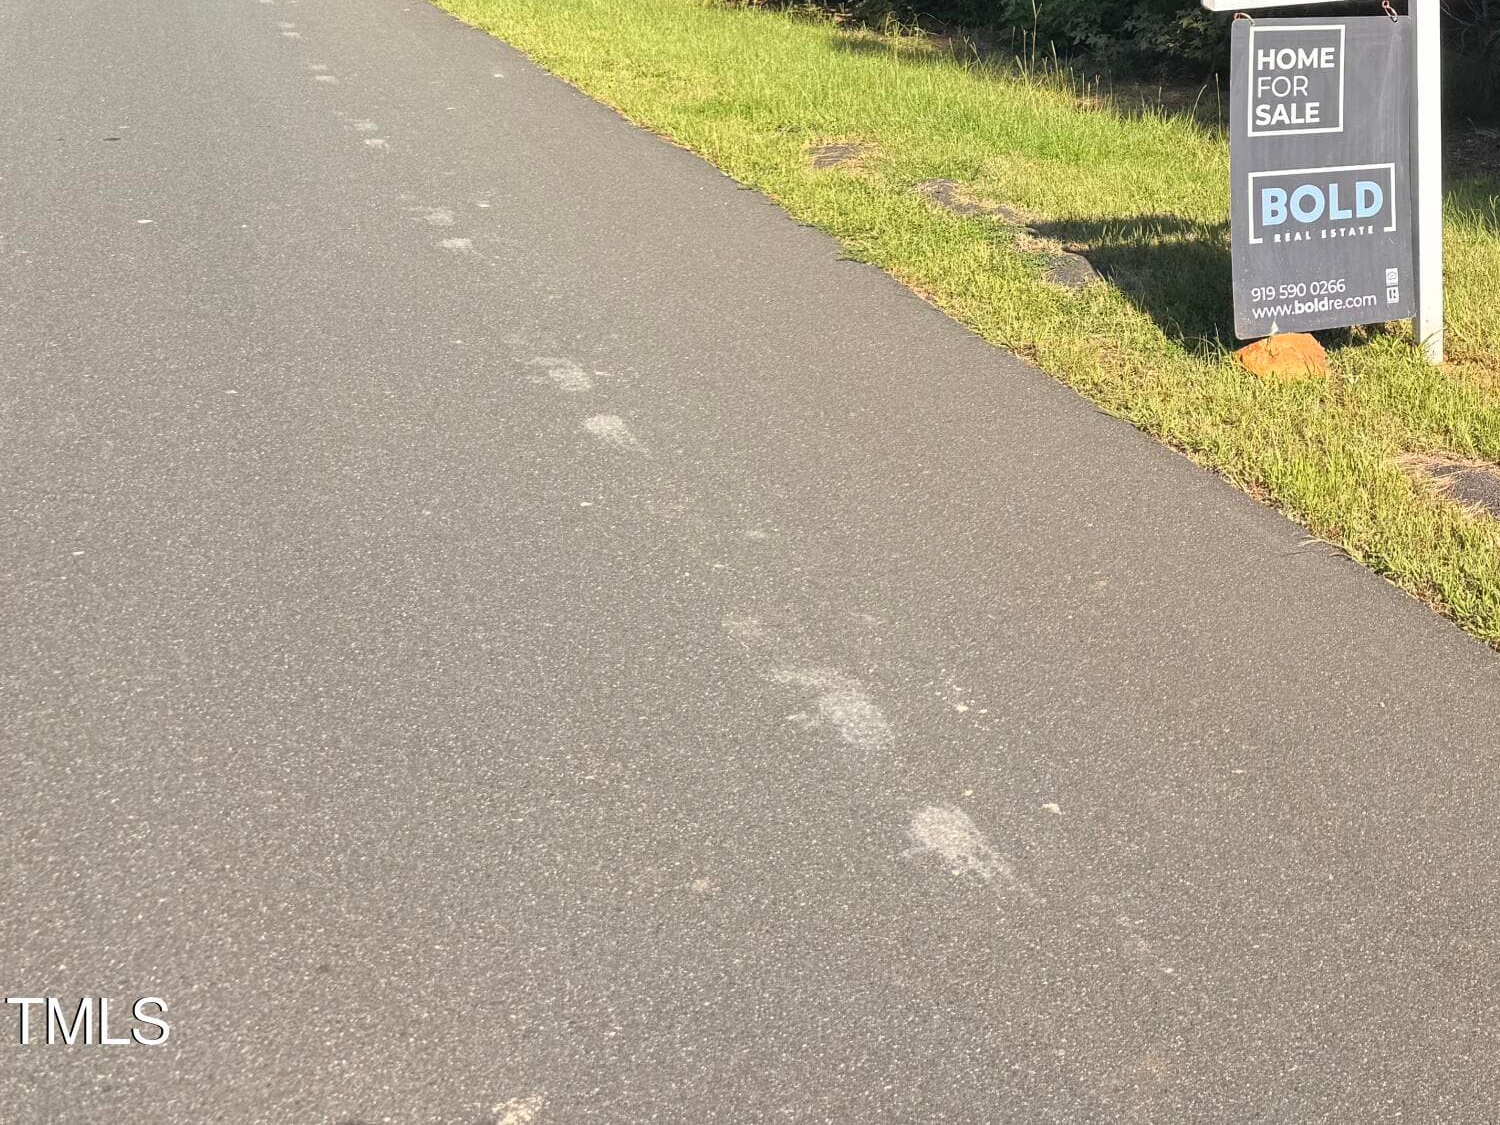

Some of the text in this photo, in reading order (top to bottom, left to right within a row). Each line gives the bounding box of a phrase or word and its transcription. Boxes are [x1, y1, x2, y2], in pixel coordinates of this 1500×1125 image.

[1257, 47, 1335, 71] HOME
[1257, 75, 1308, 98] FOR
[1255, 102, 1320, 126] SALE
[1262, 181, 1383, 226] BOLD
[1274, 226, 1374, 243] REAL ESTATE
[1251, 279, 1346, 302] 919 590 0266
[1252, 293, 1377, 319] www.boldre.com
